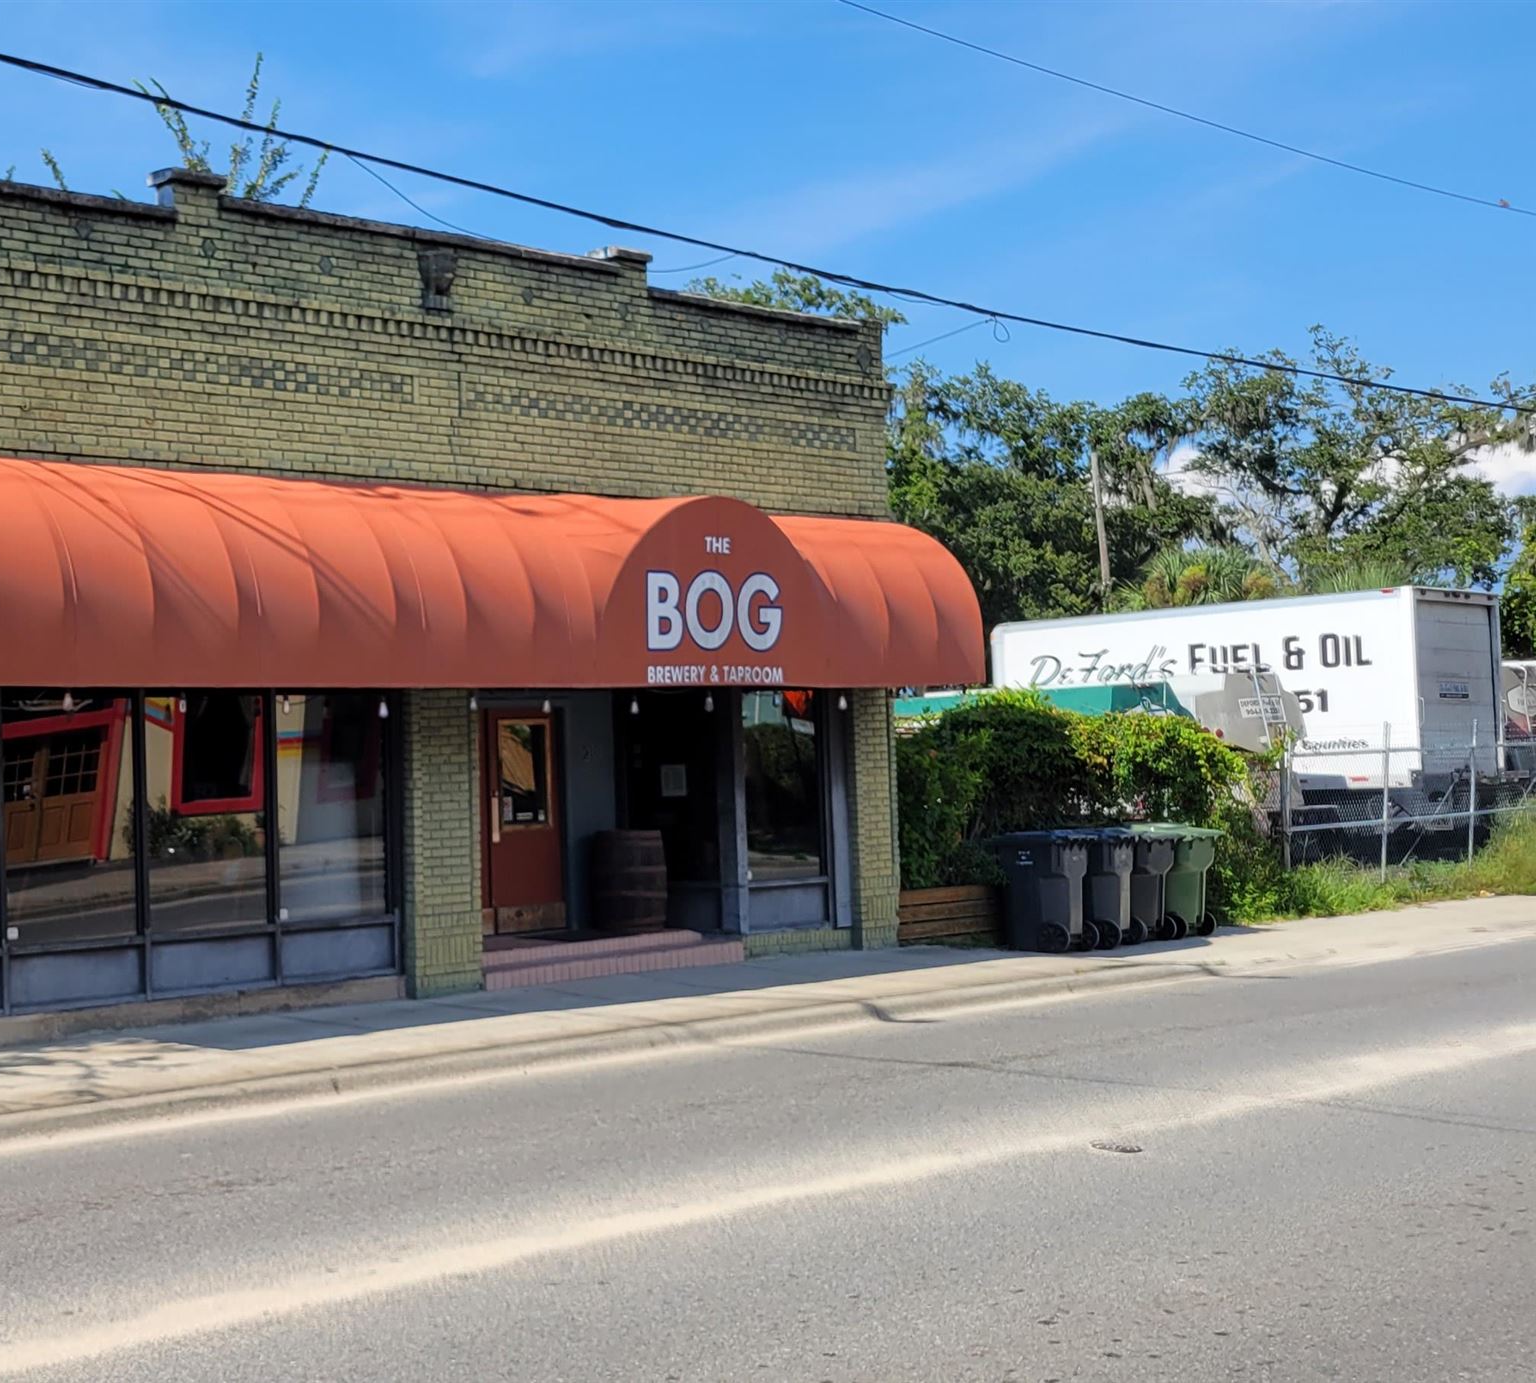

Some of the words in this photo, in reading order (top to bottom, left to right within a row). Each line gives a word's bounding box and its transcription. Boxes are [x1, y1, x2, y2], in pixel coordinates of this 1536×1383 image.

[705, 537, 731, 554] THE
[646, 569, 783, 652] BOG
[1188, 643, 1270, 674] FUEL
[1282, 636, 1305, 671] &
[1319, 633, 1373, 668] OIL
[647, 665, 706, 684] BREWERY
[710, 665, 719, 683] &
[723, 665, 784, 684] TAPROOM
